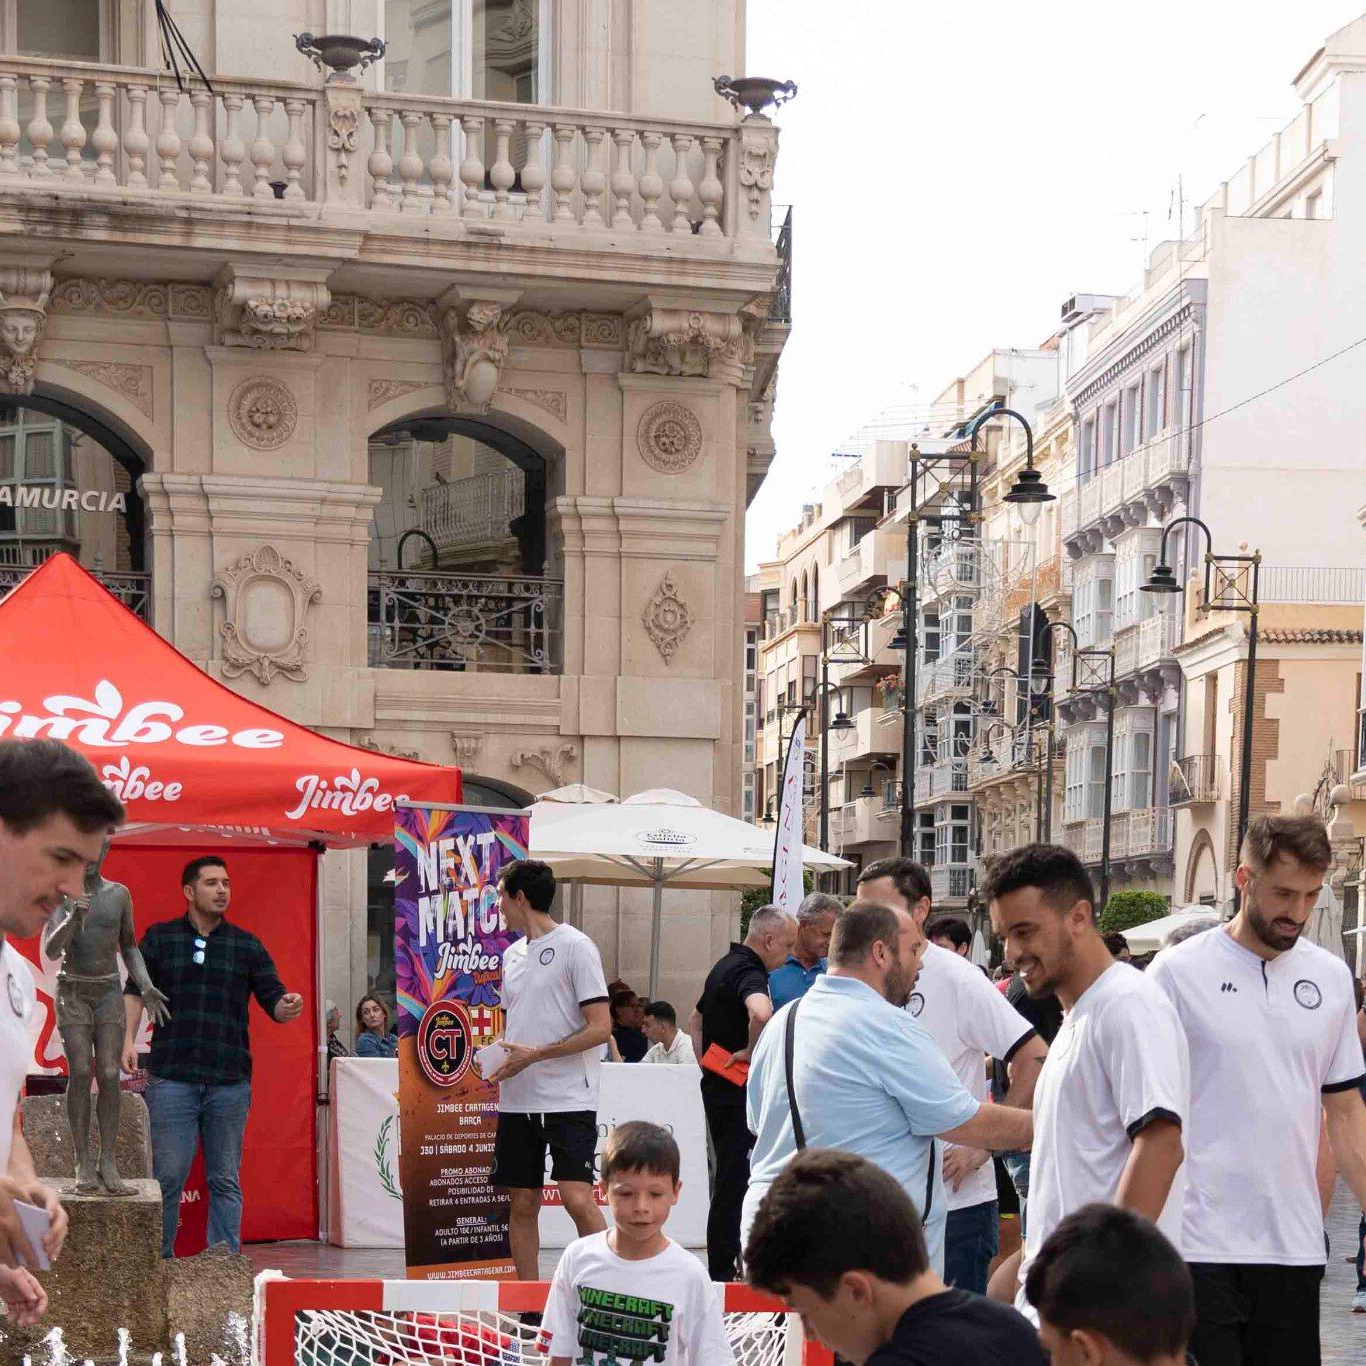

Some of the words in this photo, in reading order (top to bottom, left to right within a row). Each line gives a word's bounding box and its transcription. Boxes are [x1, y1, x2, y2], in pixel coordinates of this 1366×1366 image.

[416, 832, 496, 894] NEXT
[418, 885, 507, 948] MATC
[435, 936, 501, 980] Jimbee
[437, 1103, 463, 1113] JIMBEE
[464, 1102, 499, 1112] CARTAGEN
[439, 1143, 467, 1155] SÁBADO
[440, 1168, 464, 1176] PROMO
[464, 1166, 491, 1175] ABONAD
[429, 1177, 464, 1187] ABONADOS
[448, 1187, 486, 1196] POSIBILIDAD
[429, 1199, 454, 1207] RETIRAR
[460, 1196, 491, 1205] ENTRADAS
[435, 1228, 459, 1236] ADULTO
[448, 1236, 469, 1245] PARTIR
